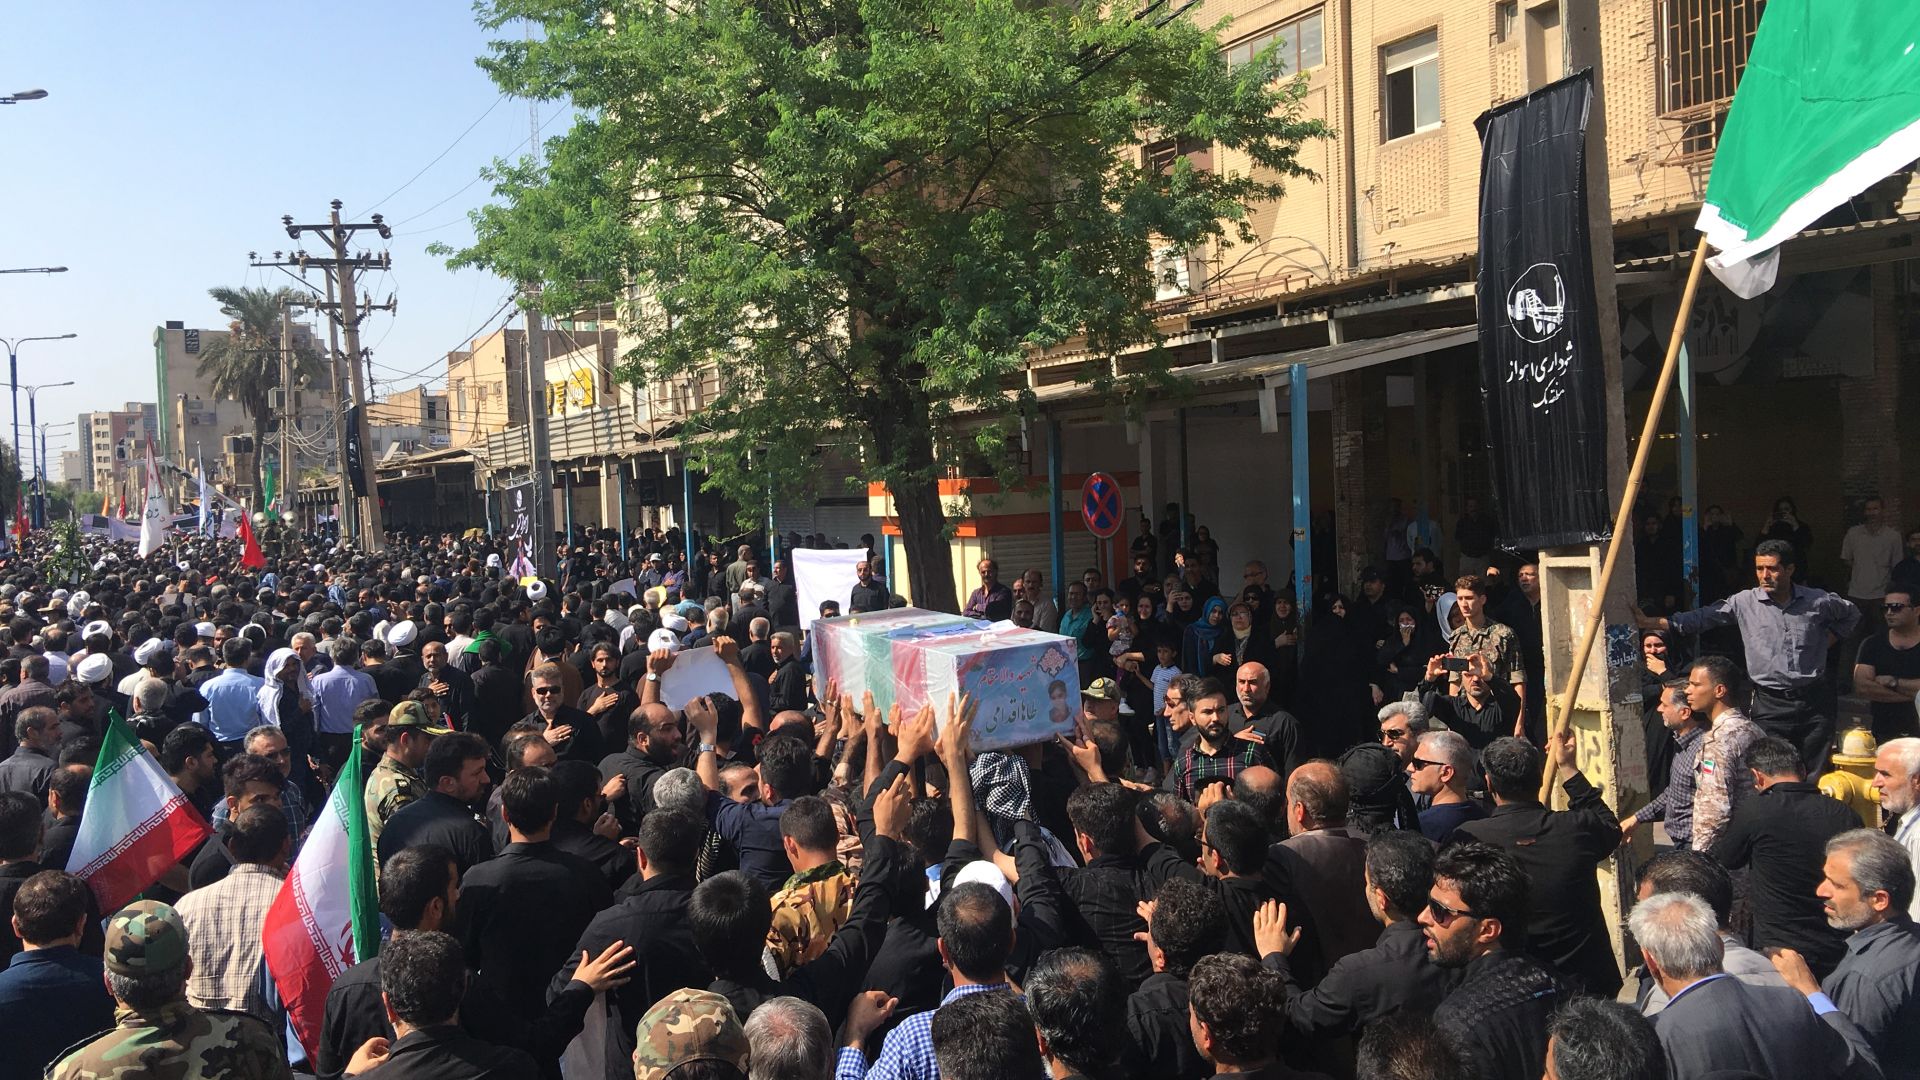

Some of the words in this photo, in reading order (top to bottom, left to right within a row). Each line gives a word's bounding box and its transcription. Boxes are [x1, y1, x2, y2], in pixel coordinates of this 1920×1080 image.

[1506, 360, 1534, 383] اهواز
[1535, 340, 1573, 382] شهرداری
[1532, 376, 1556, 415] یک
[1548, 381, 1565, 404] منطقه
[985, 697, 1020, 734] اقدامی
